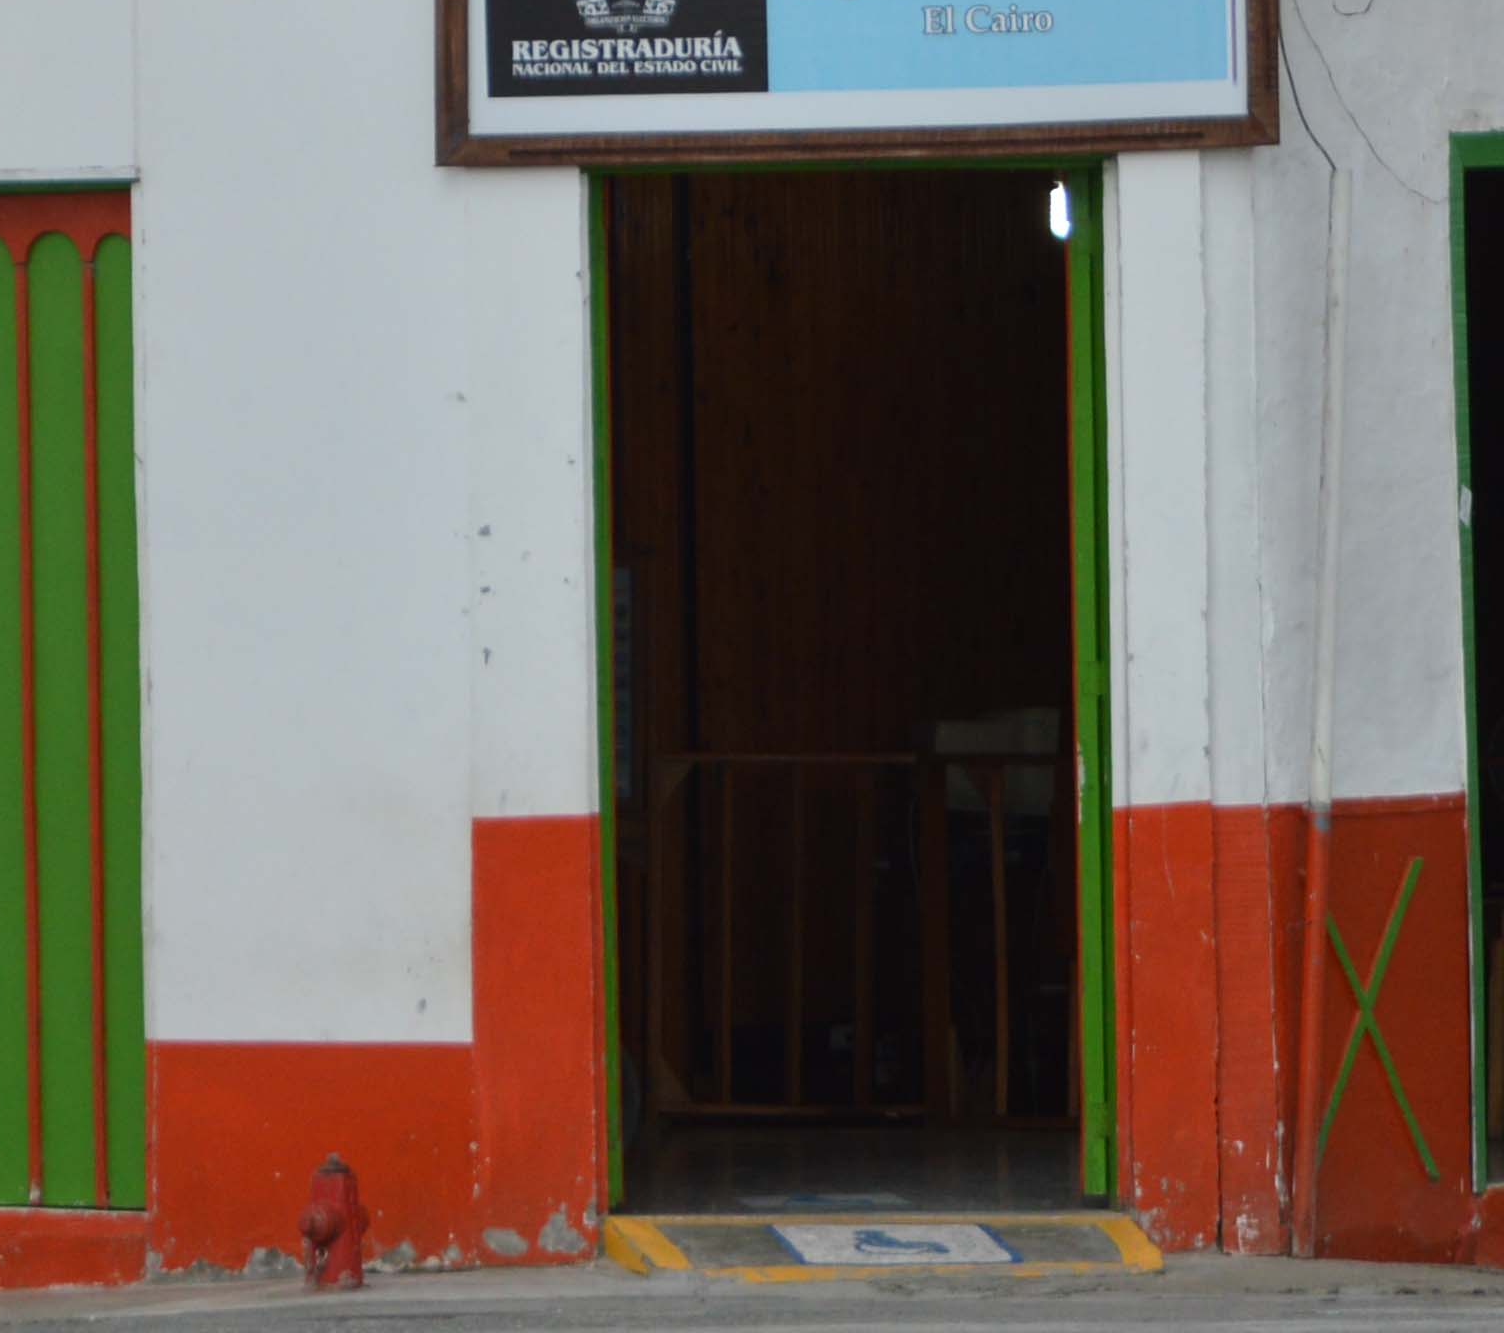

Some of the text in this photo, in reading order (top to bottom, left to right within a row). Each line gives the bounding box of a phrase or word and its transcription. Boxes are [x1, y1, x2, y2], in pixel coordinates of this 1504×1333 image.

[921, 3, 1055, 35] El Cairo
[511, 29, 743, 61] REGISTRADURÍA
[511, 58, 743, 76] NACIONAL DEL ESTADO CIVIL
